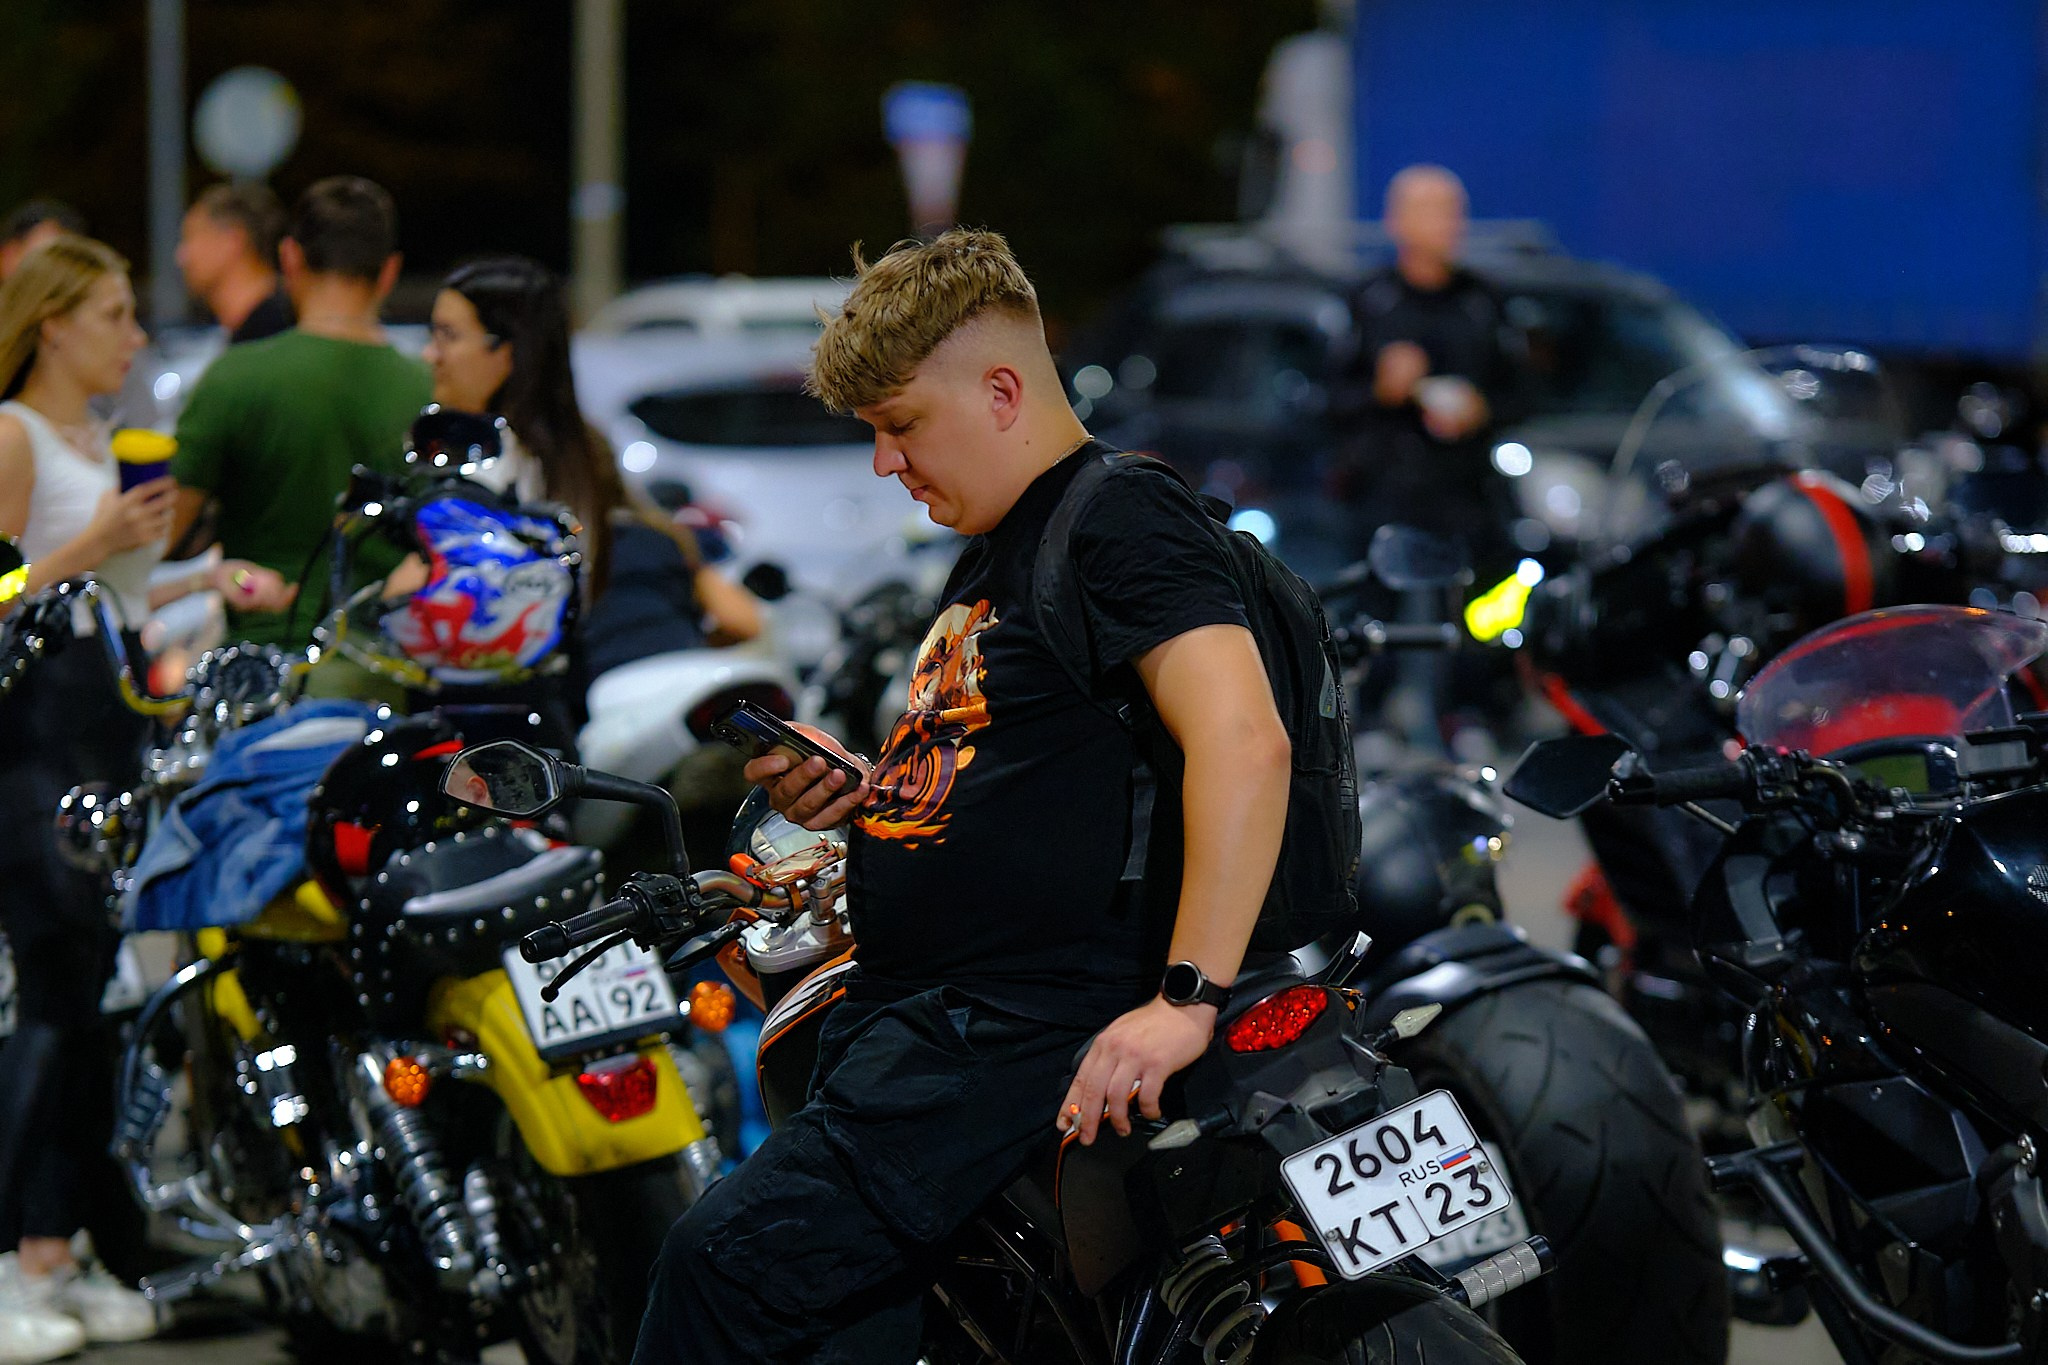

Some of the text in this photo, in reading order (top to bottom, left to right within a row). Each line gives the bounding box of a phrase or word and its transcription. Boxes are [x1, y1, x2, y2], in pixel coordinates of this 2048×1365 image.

[543, 981, 663, 1037] AA 92
[1314, 1109, 1446, 1196] 2604
[1399, 1160, 1440, 1187] RUS
[1335, 1165, 1492, 1265] KT 23
